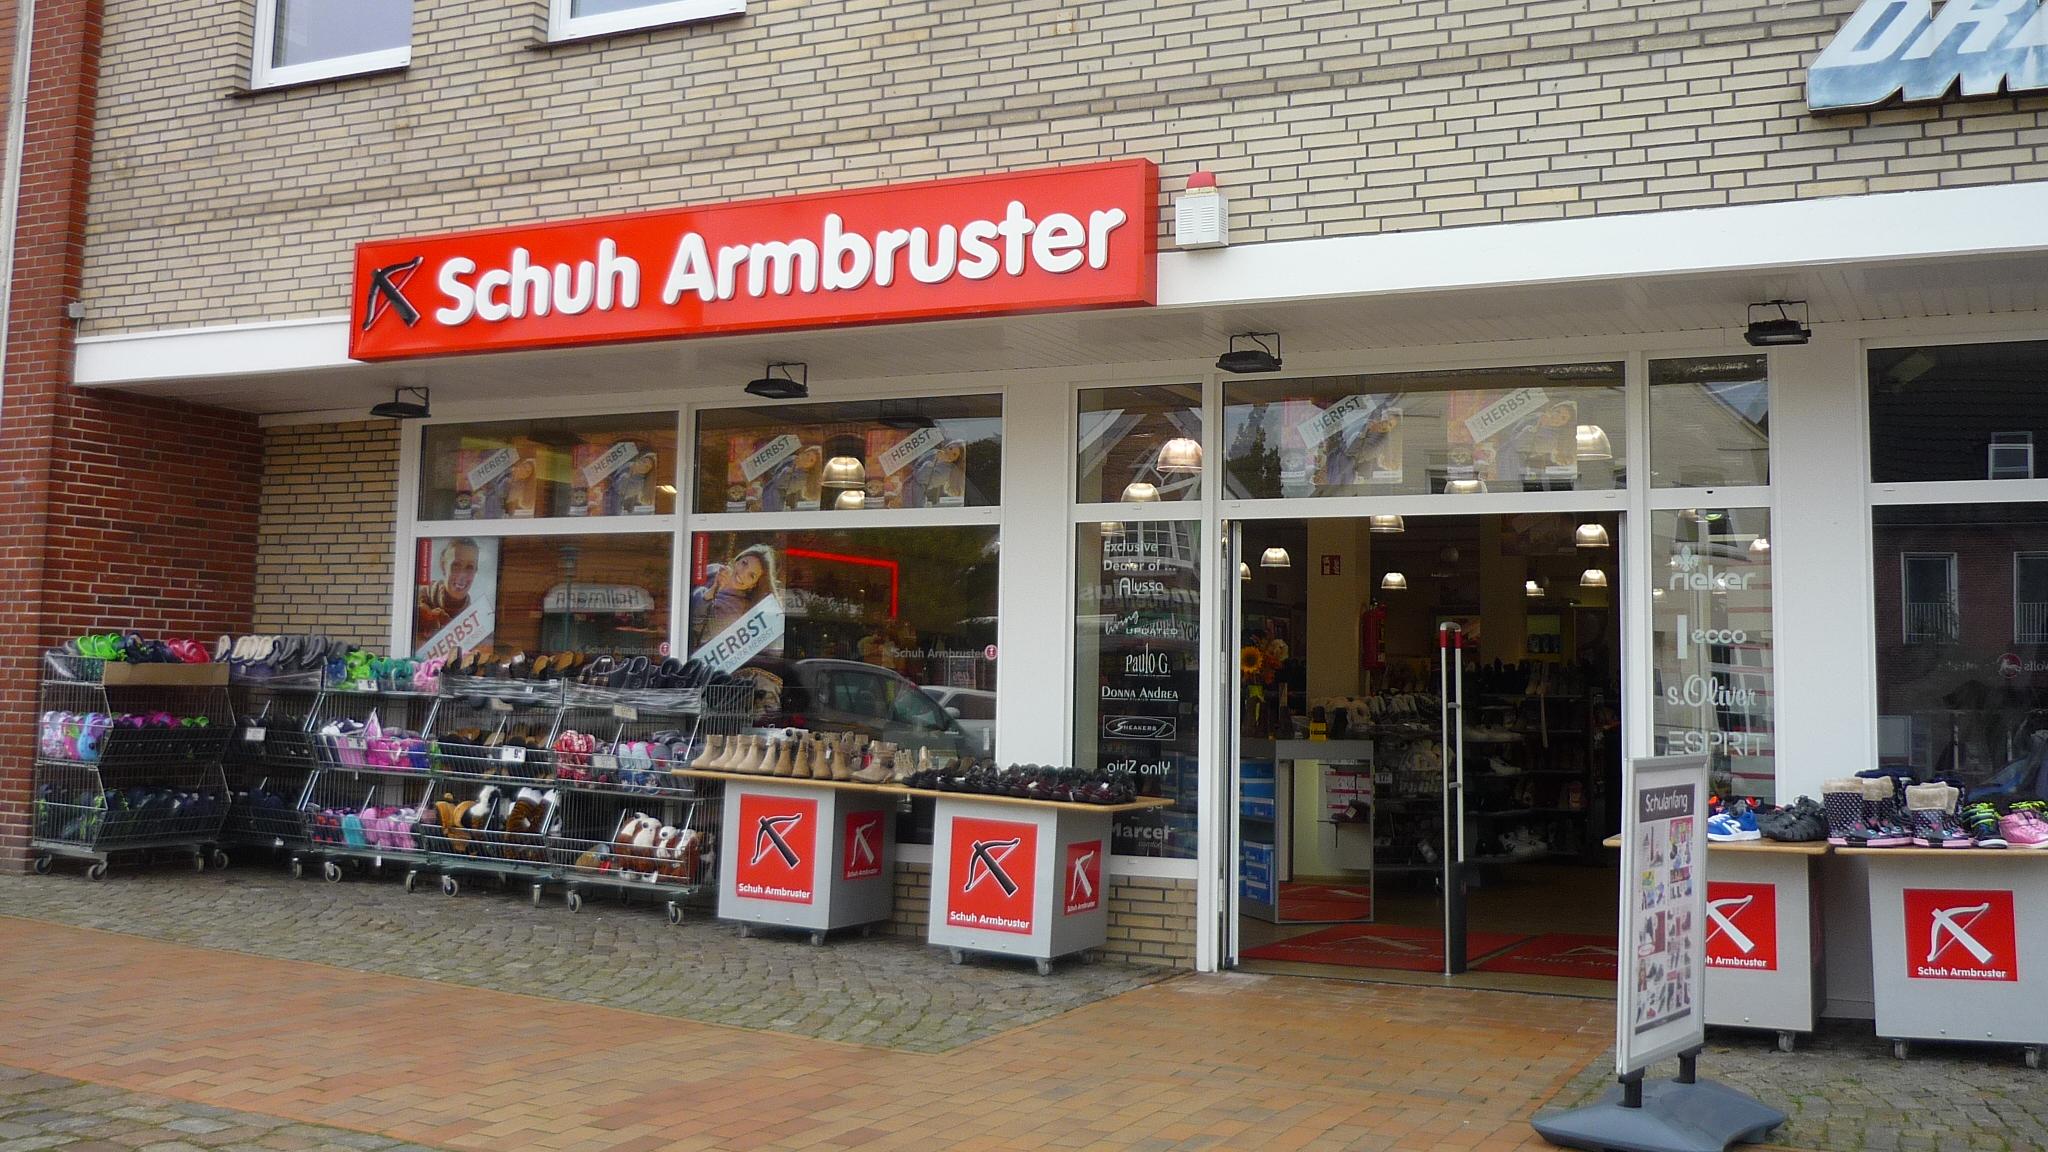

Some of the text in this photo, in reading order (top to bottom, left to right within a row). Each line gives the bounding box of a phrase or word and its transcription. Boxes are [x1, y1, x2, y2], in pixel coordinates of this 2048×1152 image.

[436, 200, 1127, 326] Schuh Armbruster
[1312, 396, 1361, 433] HERBST
[1481, 388, 1532, 427] HERBST
[594, 444, 629, 473] HERBST
[752, 437, 791, 468] HERBST
[890, 428, 933, 462] HERBST
[477, 449, 513, 479] HERBST
[1103, 540, 1158, 553] Exclusive
[1103, 560, 1145, 571] Dealer
[1148, 559, 1161, 571] of
[1669, 564, 1757, 591] rieker
[1119, 577, 1164, 596] Alyssa
[427, 610, 481, 661] HERBST
[704, 610, 769, 671] HERBST
[1125, 626, 1179, 636] UPDATED
[1691, 628, 1747, 645] ecco
[893, 647, 925, 658] Schuh
[1125, 642, 1171, 674] Paulo G.
[1667, 674, 1757, 708] s.Oliver
[1668, 730, 1767, 757] ESPRIT
[1106, 759, 1171, 776] girlZ onlY
[1645, 789, 1688, 813] Schulanfang
[738, 882, 811, 899] Schuh Armbruster
[950, 911, 1030, 929] Schuh Armbruster
[1715, 955, 1768, 967] Armbruster
[1917, 965, 2007, 979] Schuh Armbruster
